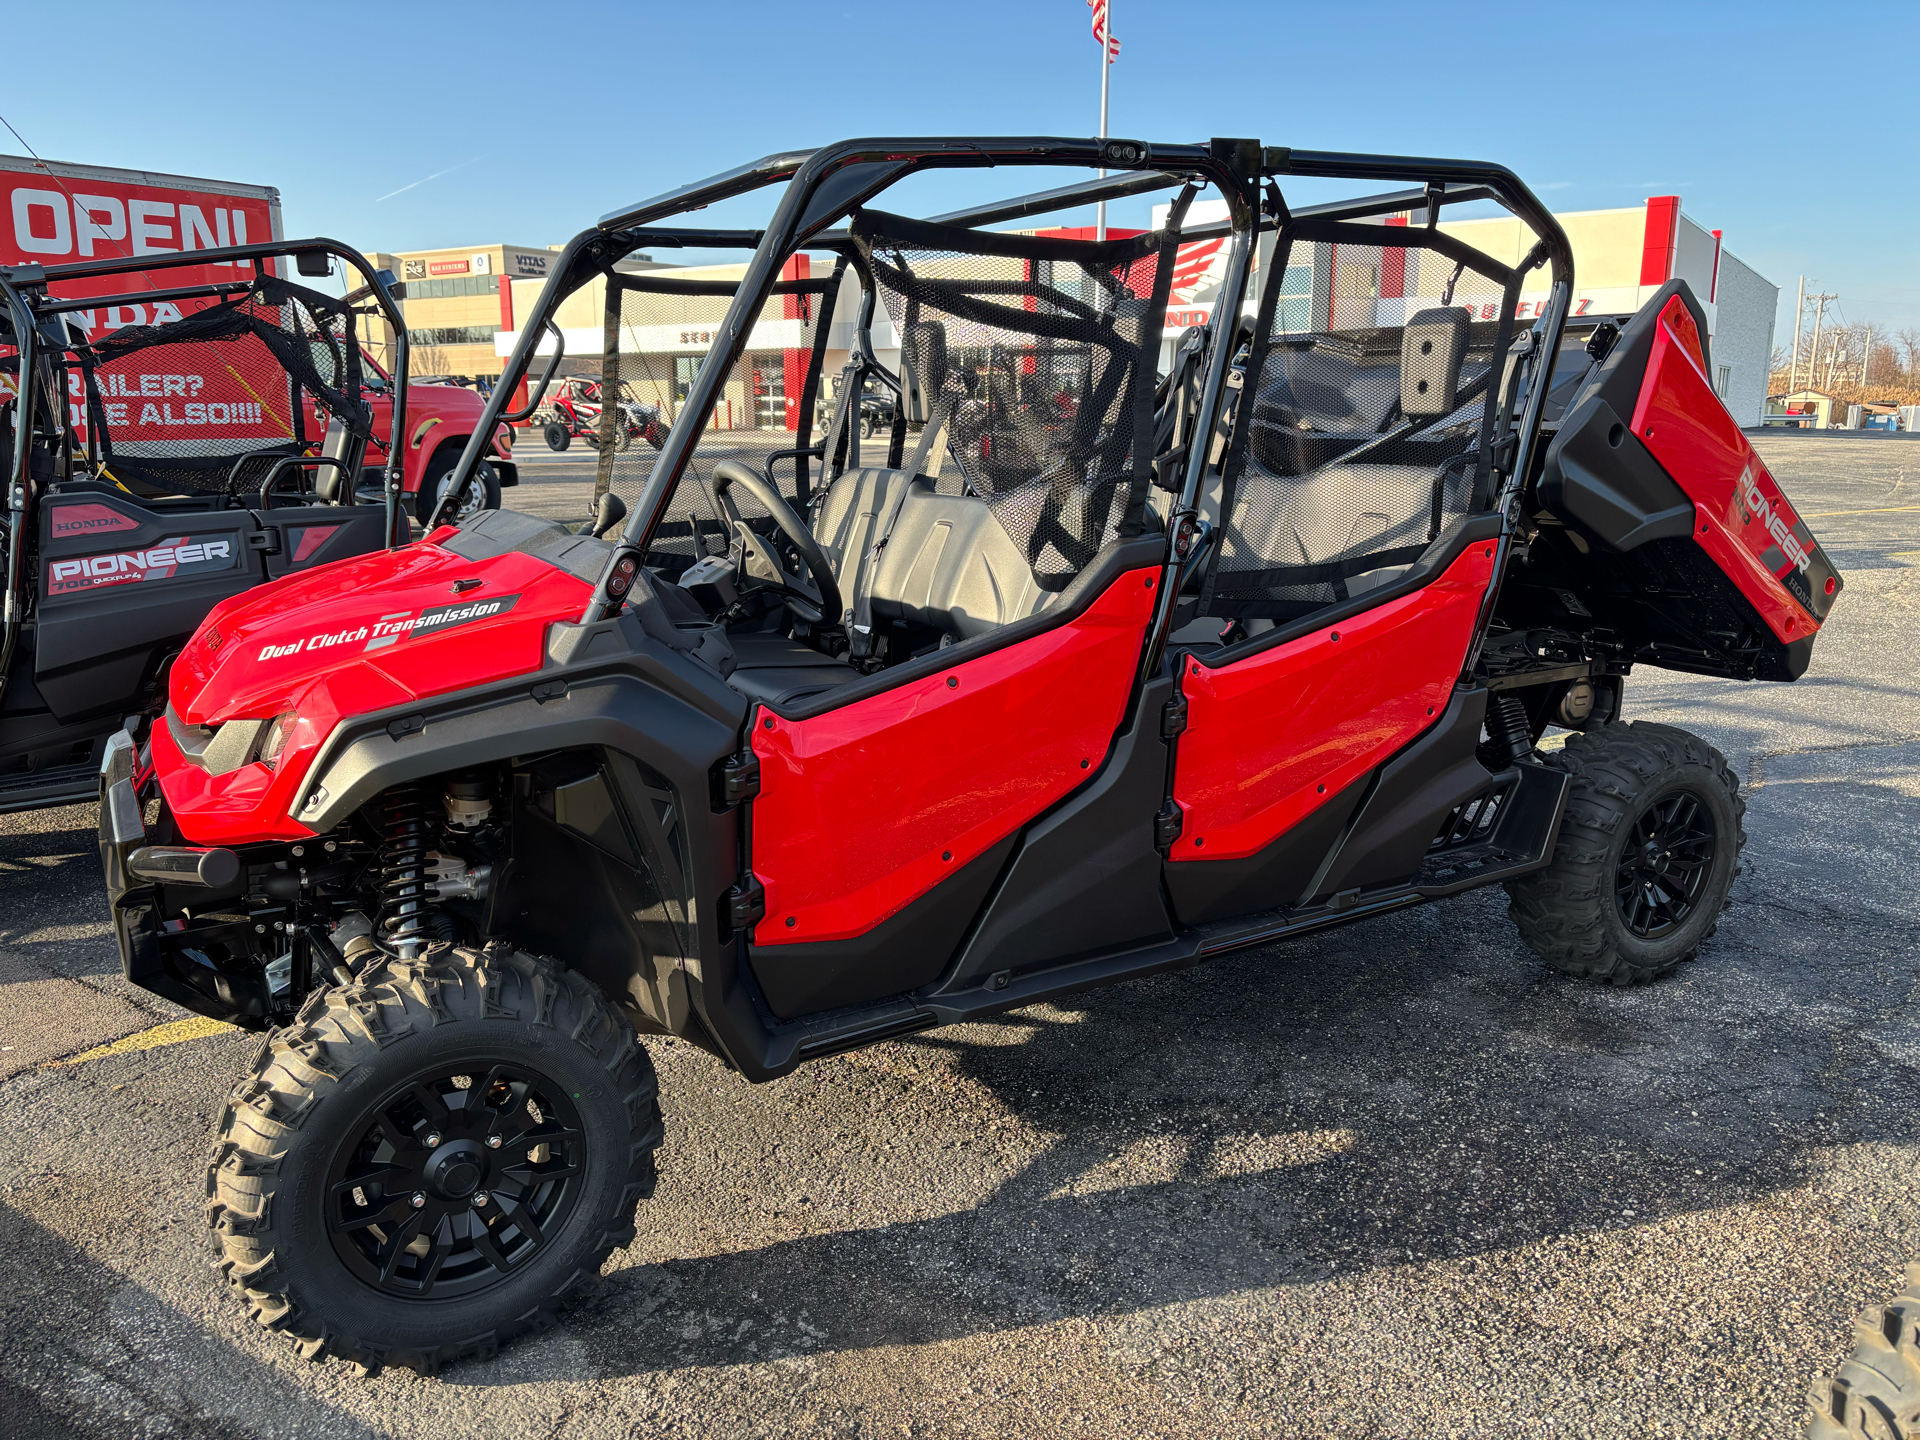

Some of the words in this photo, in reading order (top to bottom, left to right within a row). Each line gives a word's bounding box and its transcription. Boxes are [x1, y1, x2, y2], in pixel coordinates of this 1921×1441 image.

[11, 188, 251, 268] OPEN!
[516, 255, 546, 268] VITAS
[55, 517, 123, 532] HONDA
[1731, 485, 1752, 526] 1000
[1739, 465, 1812, 576] PIONEER
[52, 540, 230, 582] PIONEER
[52, 578, 93, 591] 700
[1788, 576, 1819, 617] HONDA
[258, 642, 304, 661] Dual
[306, 626, 369, 650] Clutch
[372, 601, 501, 637] Transmission
